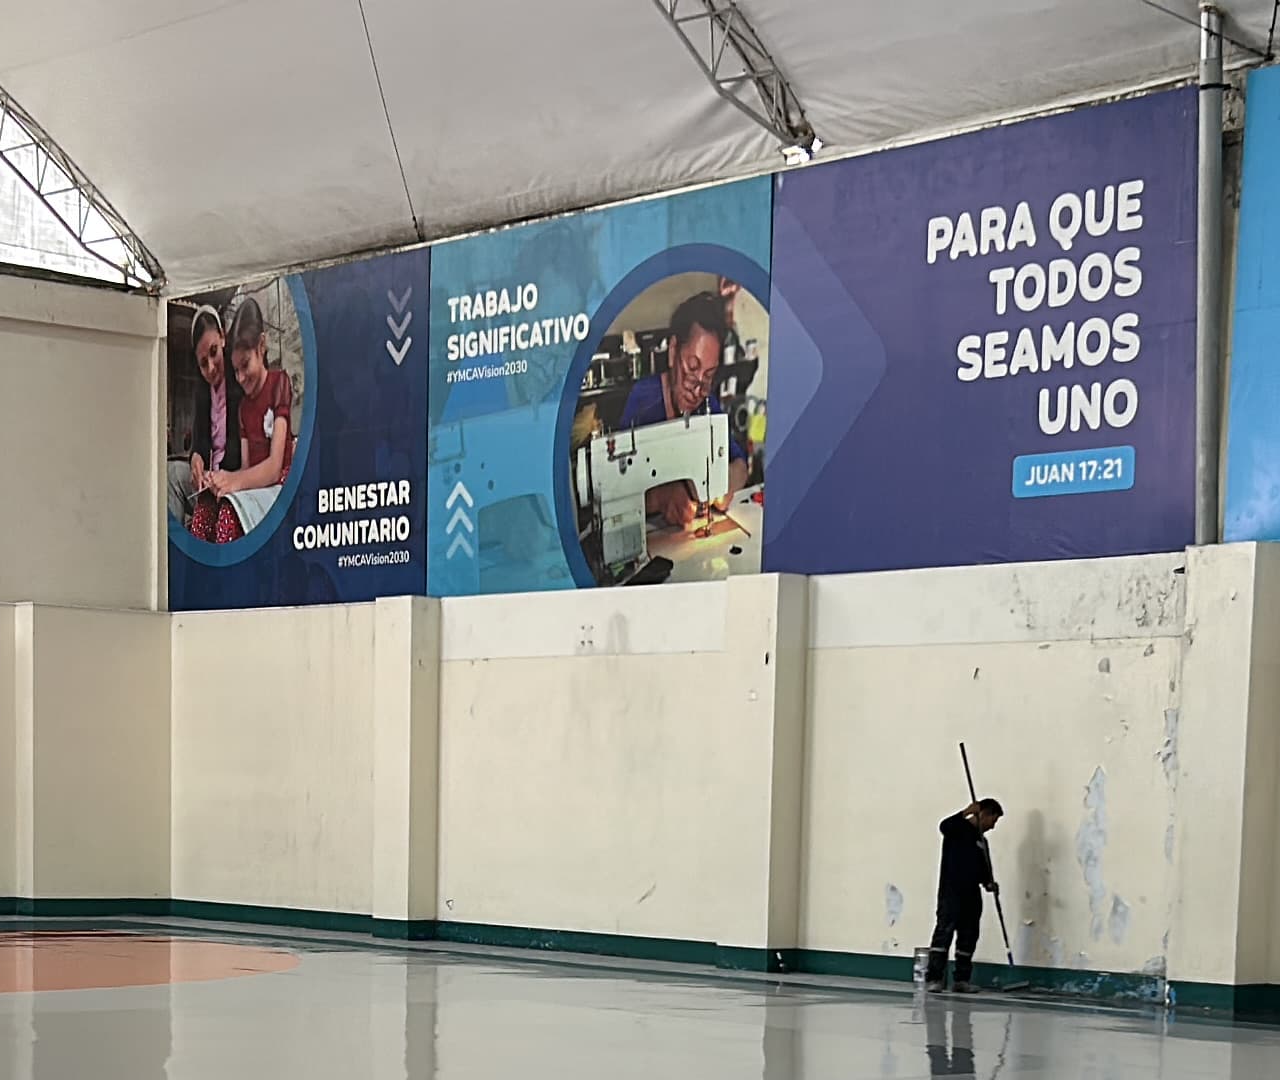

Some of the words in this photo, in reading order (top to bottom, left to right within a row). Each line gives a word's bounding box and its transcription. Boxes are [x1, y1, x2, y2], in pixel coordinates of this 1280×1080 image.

[927, 201, 1037, 264] PARA
[1049, 179, 1145, 251] QUE
[989, 247, 1143, 316] TODOS
[447, 282, 538, 323] TRABAJO
[447, 312, 590, 361] SIGNIFICATIVO
[957, 312, 1142, 382] SEAMOS
[446, 359, 528, 384] #YMCAVision2030
[1038, 378, 1139, 435] UNO
[1024, 462, 1074, 486] JUAN
[1079, 458, 1123, 480] 17:21
[318, 480, 410, 513] BIENESTAR
[293, 515, 410, 550] COMUNITARIO
[338, 550, 410, 568] #YMCAVision2030
